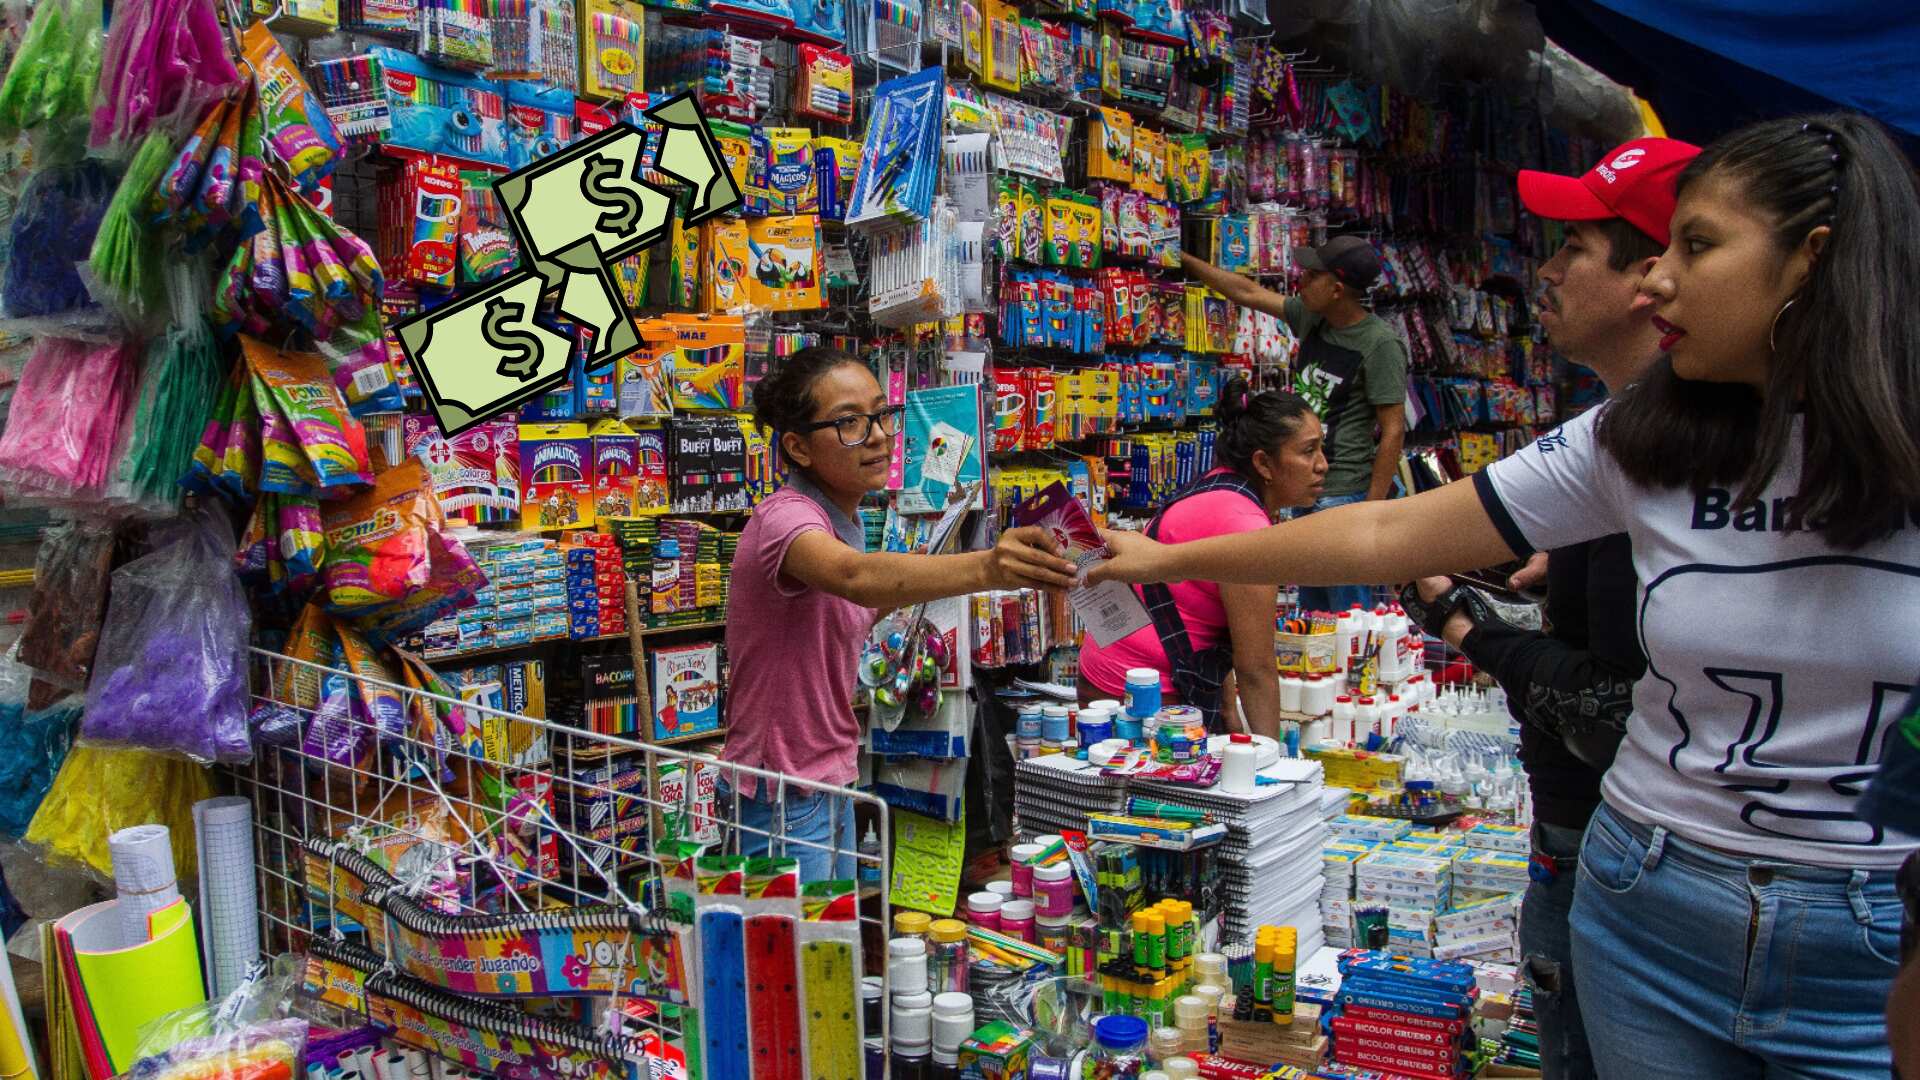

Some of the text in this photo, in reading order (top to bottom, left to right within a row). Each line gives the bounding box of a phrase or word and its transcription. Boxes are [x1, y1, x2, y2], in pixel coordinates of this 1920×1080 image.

[680, 438, 711, 453] BUFFY
[713, 437, 743, 452] BUFFY
[534, 446, 580, 469] ANIMALITOS
[480, 956, 540, 973] Jugando
[1355, 1023, 1432, 1041] BICOLOR GRUESO
[1358, 1038, 1435, 1057] BICOLOR GRUESO
[1357, 1052, 1434, 1071] BICOLOR GRUESO
